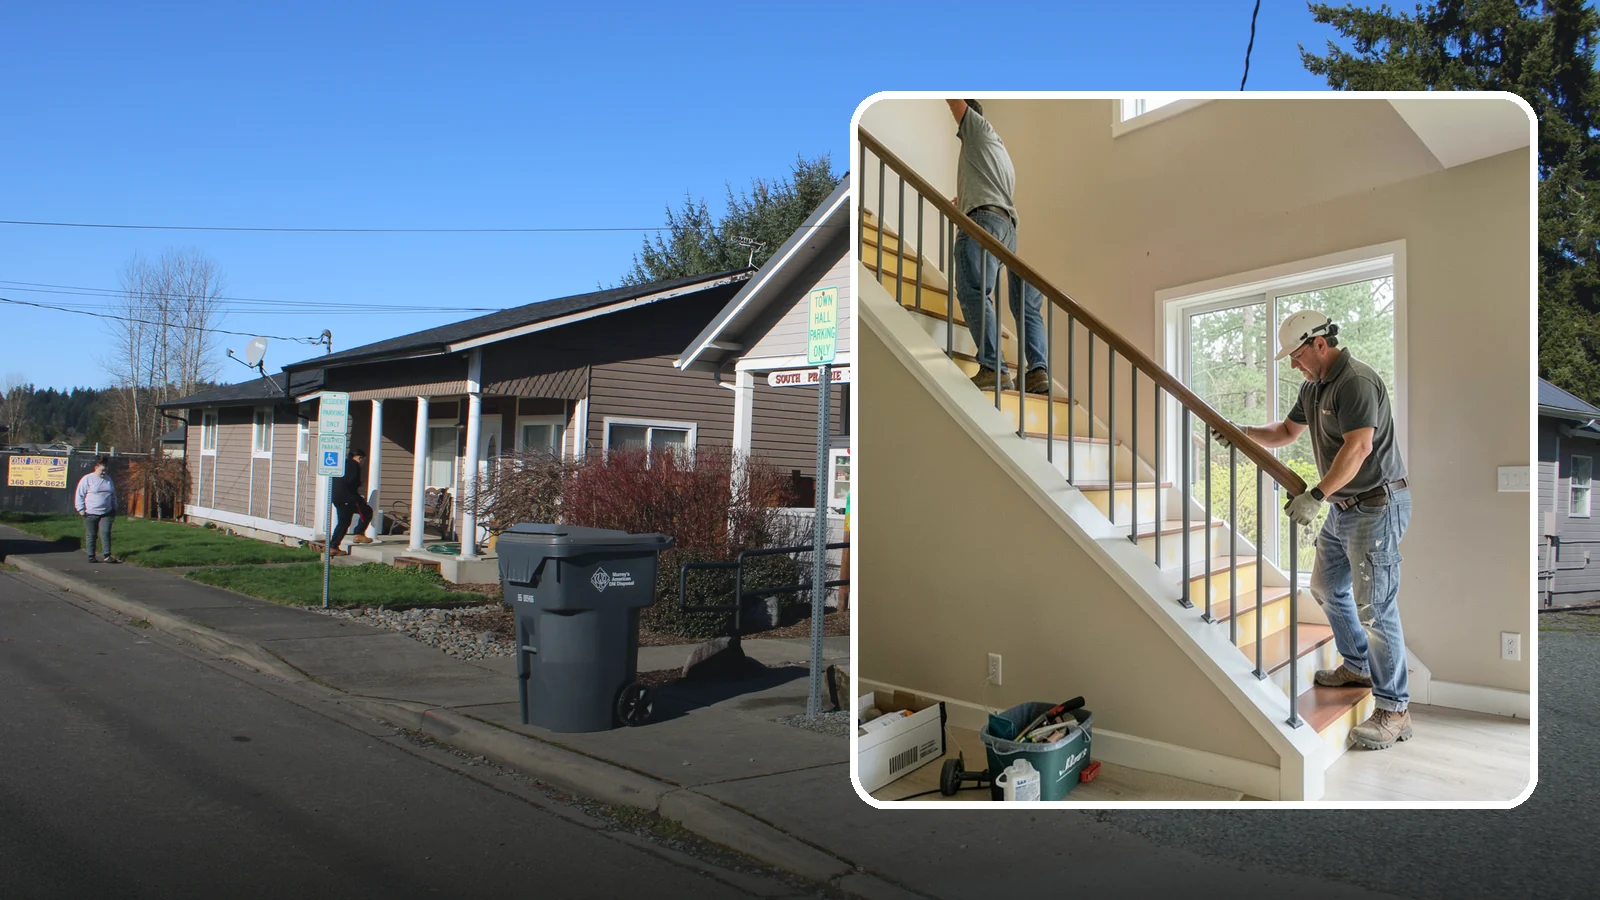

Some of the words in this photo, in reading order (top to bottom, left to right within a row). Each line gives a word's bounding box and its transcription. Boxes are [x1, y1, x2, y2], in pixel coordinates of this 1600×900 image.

[815, 295, 832, 307] TOWN
[815, 311, 831, 325] HALL
[810, 326, 836, 341] PARKING
[813, 344, 831, 357] ONLY
[775, 374, 801, 384] SOUTH
[808, 371, 841, 382] PRIE
[323, 409, 345, 417] PARKING
